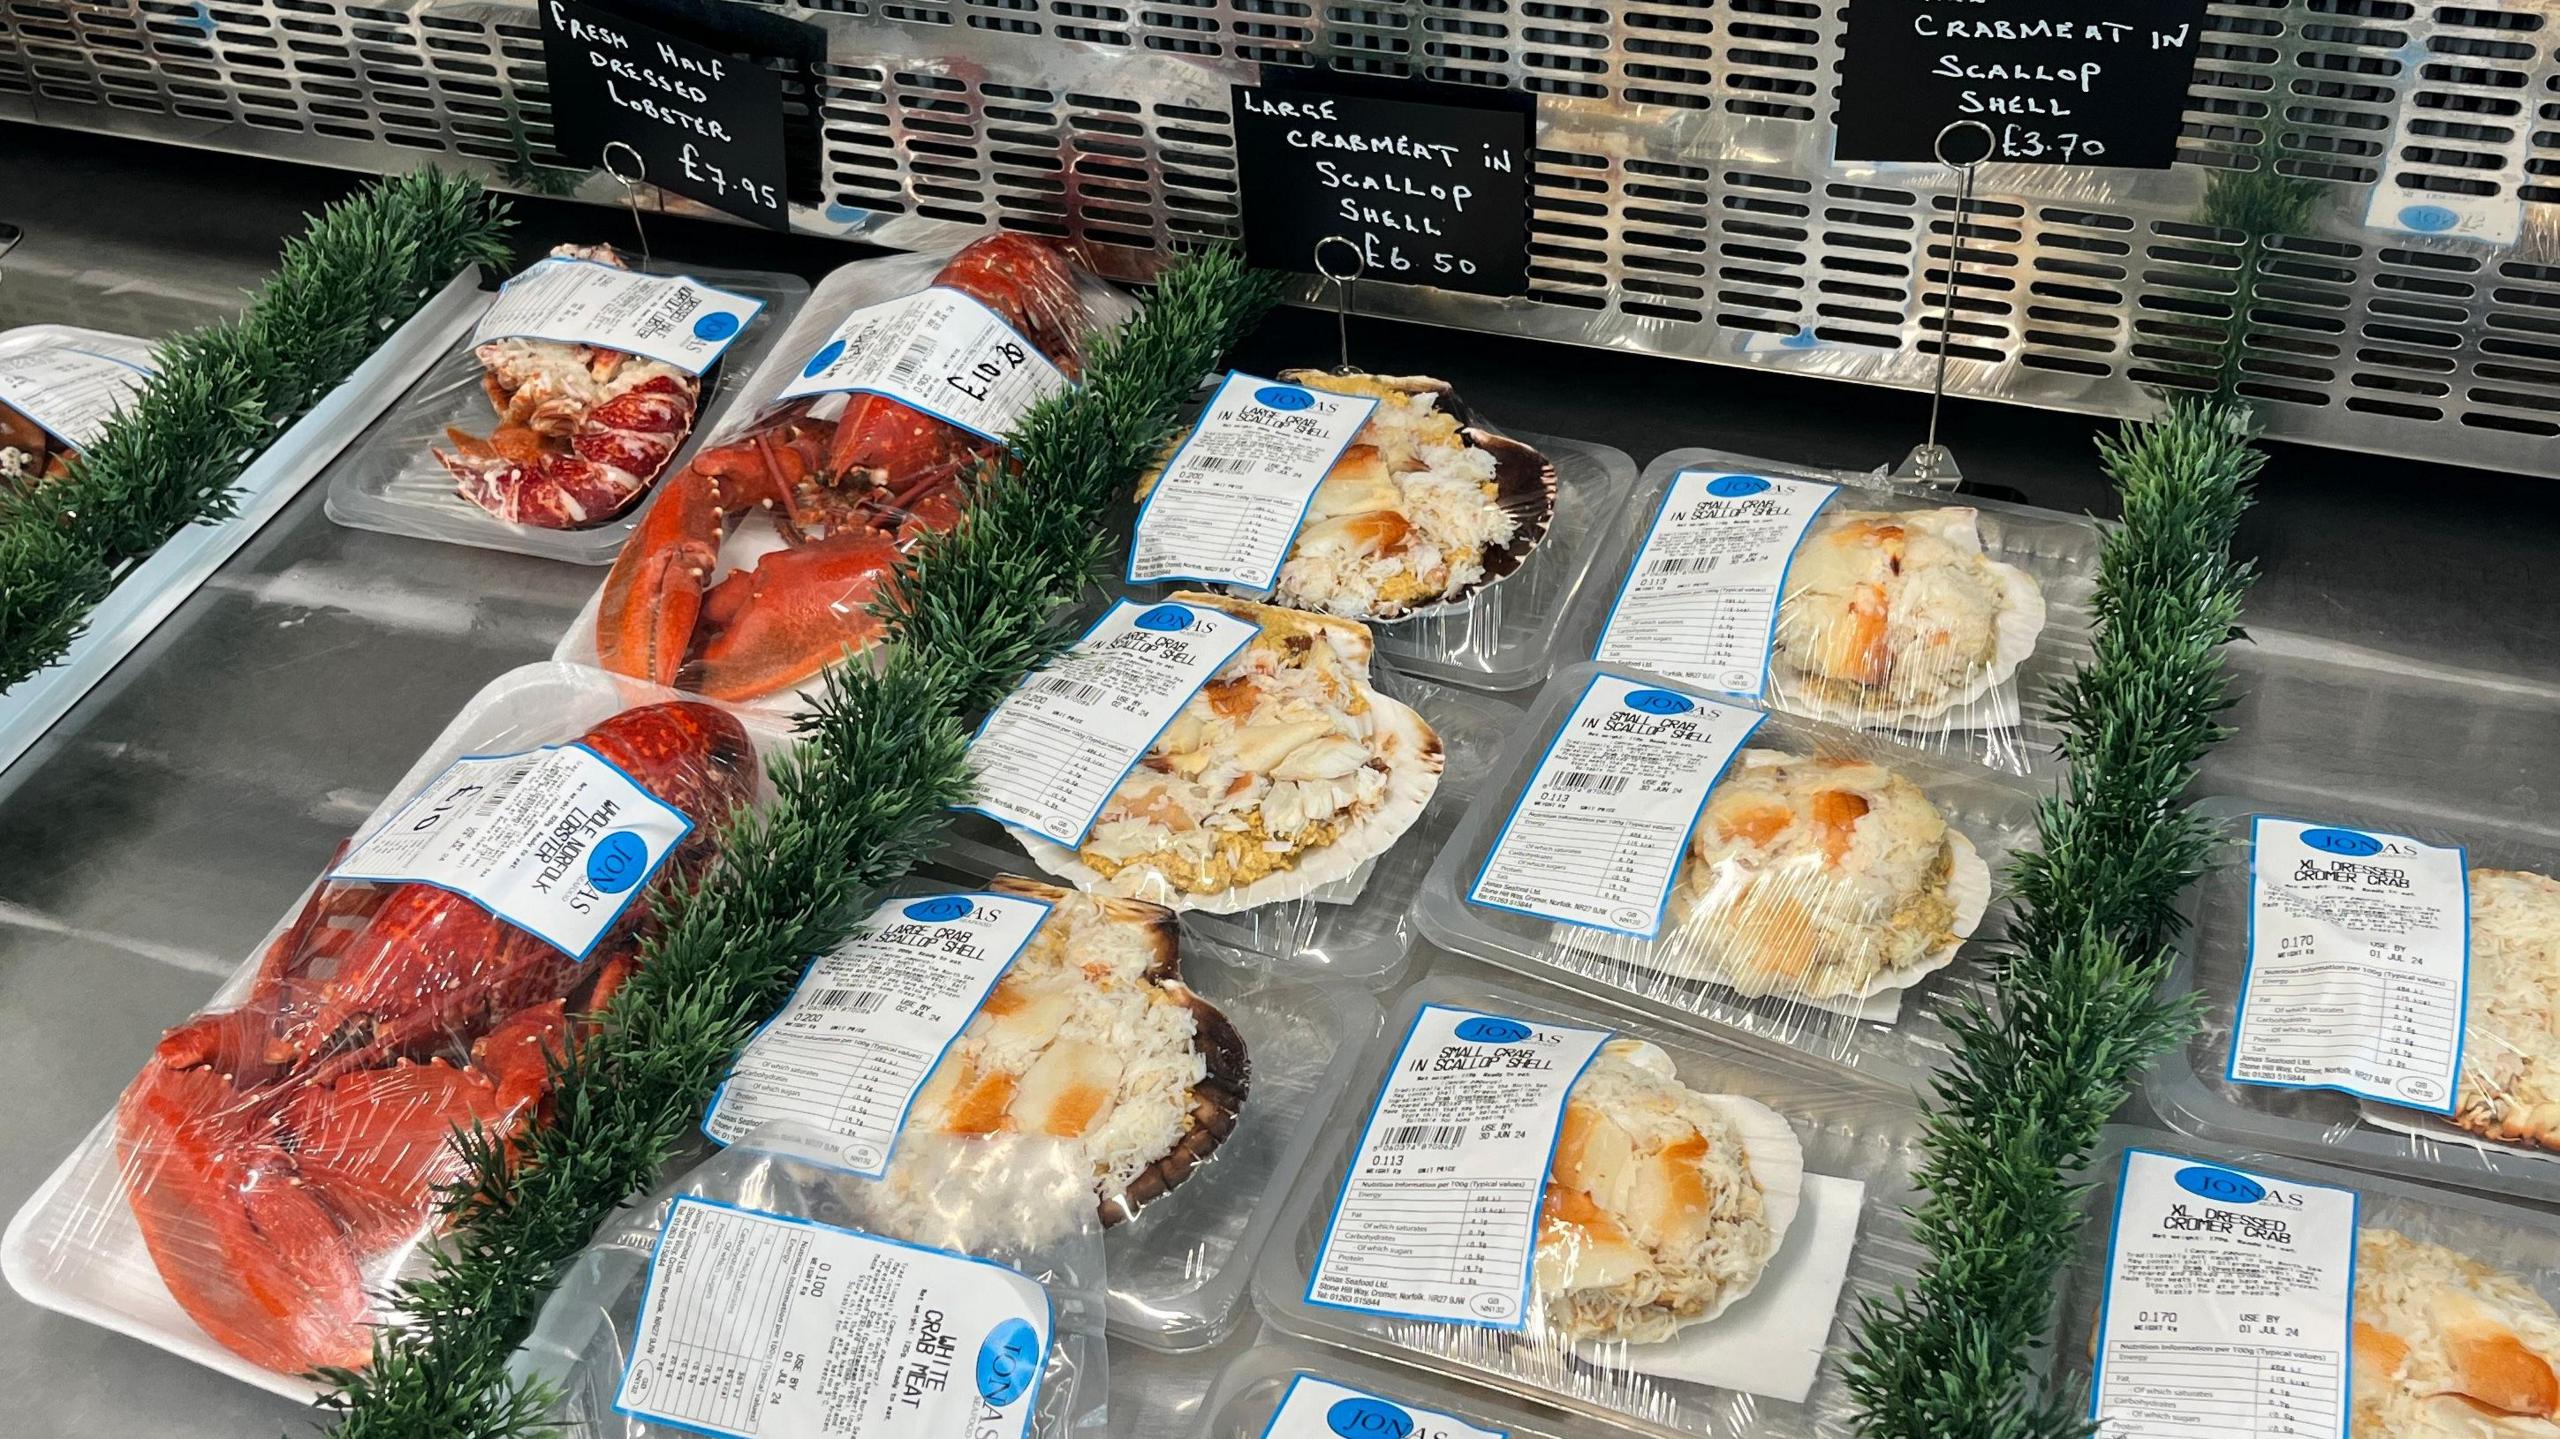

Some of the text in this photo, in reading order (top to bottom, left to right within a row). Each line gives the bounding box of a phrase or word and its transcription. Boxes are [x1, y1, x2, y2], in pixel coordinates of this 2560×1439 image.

[550, 1, 725, 81] FRESH HALF
[1914, 14, 2190, 50] CRABMEAT IN
[589, 51, 707, 104] DRESSED
[1932, 54, 2101, 93] SCALLOP
[607, 80, 732, 143] LOBSTER
[1244, 90, 1338, 121] LARGE
[1958, 90, 2071, 116] SHELL
[1286, 130, 1459, 168] CRABMEAT
[2002, 123, 2105, 163] £3.70
[678, 142, 778, 209] £7.95
[1315, 161, 1473, 213] SCALLOP
[1339, 197, 1442, 237] SHELL
[1272, 393, 1339, 413] JONAS
[1217, 410, 1330, 439] IN SCALLOP SHELL
[1241, 405, 1318, 427] LARGE CRAB
[1724, 481, 1797, 494] JONAS
[1670, 507, 1792, 521] IN SCALLOP SHELL
[1696, 500, 1775, 510] SMALL CRAB
[1148, 612, 1218, 634] JONAS
[1154, 637, 1189, 652] CRAB
[1159, 650, 1196, 666] SHELL
[1643, 696, 1723, 718] JONAS
[1582, 717, 1713, 744] IN SCALLOP SHELL
[1609, 711, 1697, 731] SMALL CRAB
[531, 798, 621, 895] WHOLE NORFOLK
[533, 806, 589, 866] LOBSTER
[2325, 835, 2418, 856] JONAS
[569, 840, 633, 915] JONAS
[2294, 870, 2410, 889] CROMER CRAB
[2299, 860, 2405, 879] XL DRESSED
[918, 903, 1002, 923] JONAS
[884, 923, 973, 943] LARGE CRAB
[876, 934, 938, 948] SCALLOP
[941, 941, 986, 961] SHELL
[2369, 949, 2423, 966] 01 JUL 24
[2370, 941, 2407, 952] USE BY
[900, 999, 916, 1007] USE
[909, 1009, 925, 1018] JUL
[1470, 1023, 1564, 1044] JONAS
[1439, 1046, 1535, 1059] SMALL CRAB
[1409, 1057, 1553, 1072] IN SCALLOP SHELL
[1494, 1131, 1510, 1139] JUN
[1515, 1130, 1526, 1138] 24
[1372, 1155, 1404, 1167] 0.113
[2203, 1176, 2304, 1206] JONAS
[2171, 1204, 2286, 1232] XL DRESSED
[1345, 1233, 1396, 1242] Carbohydrates
[2164, 1216, 2291, 1244] CROMER CRAB
[810, 1262, 832, 1298] 0.100
[1345, 1277, 1374, 1287] Seafood
[2139, 1311, 2178, 1323] 0.170
[2240, 1313, 2281, 1323] USE BY
[2239, 1324, 2299, 1337] 01 JUL 24
[901, 1309, 944, 1409] CRAB MEAT
[924, 1334, 957, 1393] WHITE
[769, 1351, 793, 1405] 01 JUL 24
[788, 1353, 806, 1391] USE BY
